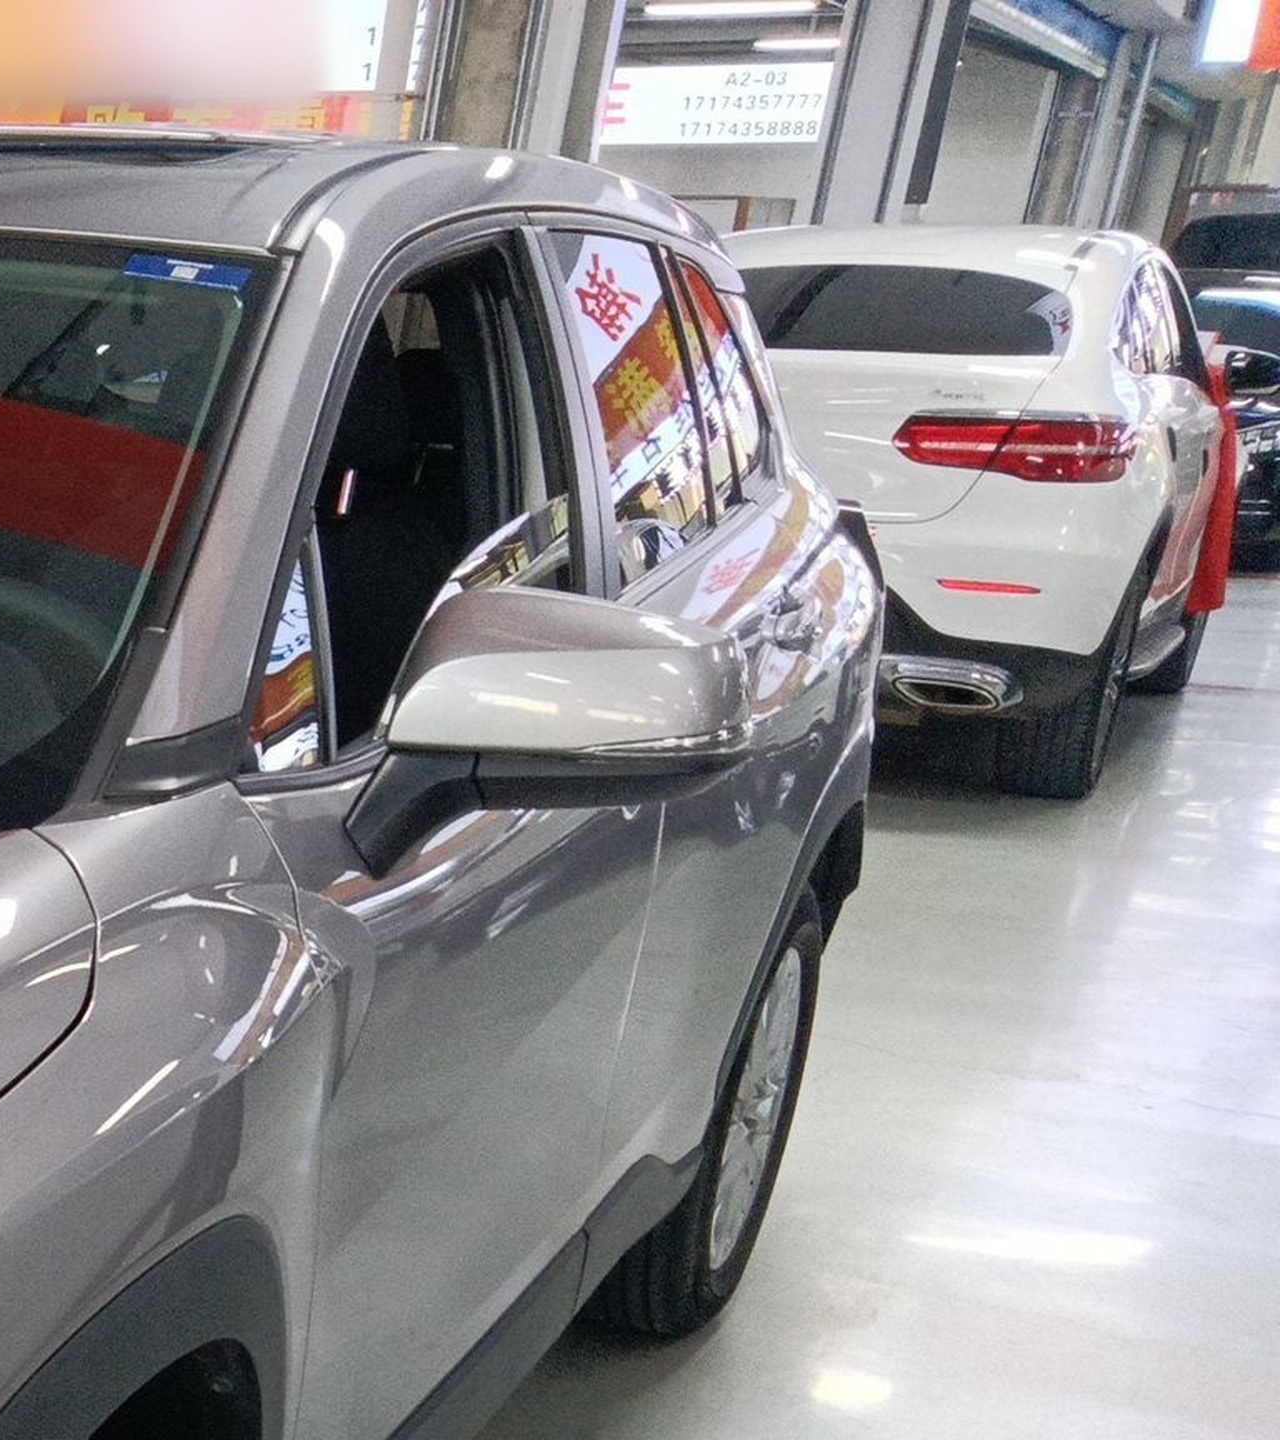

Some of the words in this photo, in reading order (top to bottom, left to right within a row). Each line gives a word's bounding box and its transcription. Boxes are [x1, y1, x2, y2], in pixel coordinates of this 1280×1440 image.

[724, 70, 788, 87] A2-03
[683, 94, 823, 111] 17174357777
[678, 120, 819, 137] 17174358888
